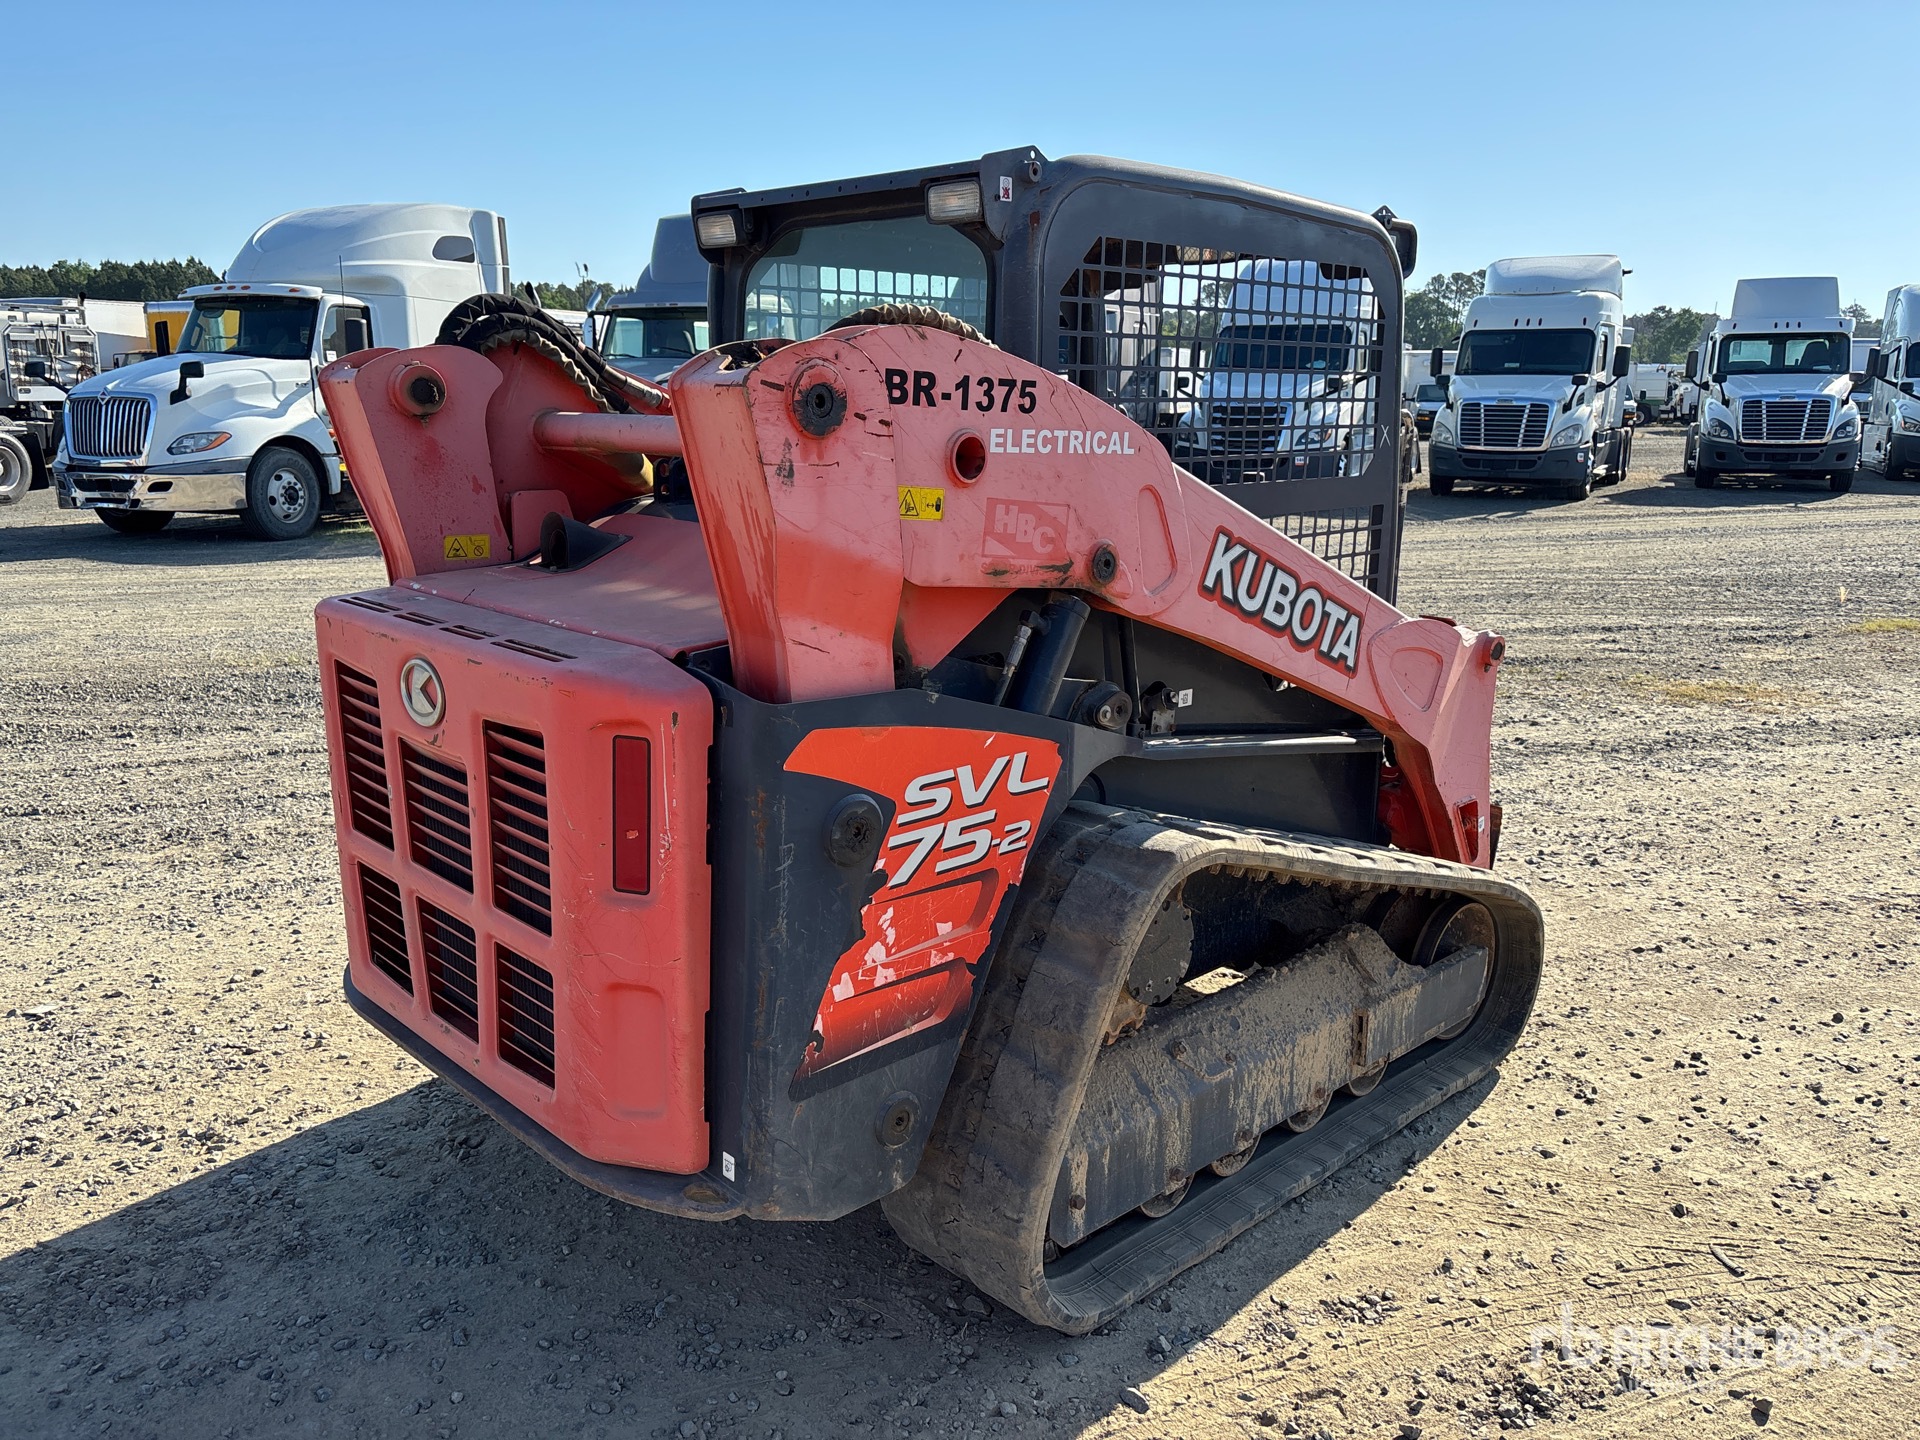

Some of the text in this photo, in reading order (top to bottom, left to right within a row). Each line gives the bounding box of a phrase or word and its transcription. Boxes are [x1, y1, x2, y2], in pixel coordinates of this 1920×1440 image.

[885, 368, 1037, 414] BR-1375
[989, 428, 1135, 455] ELECTRICAL
[993, 504, 1056, 554] HBC
[1203, 532, 1361, 670] KUBOTA
[896, 751, 1050, 826] SVL
[887, 808, 1032, 889] 75-2
